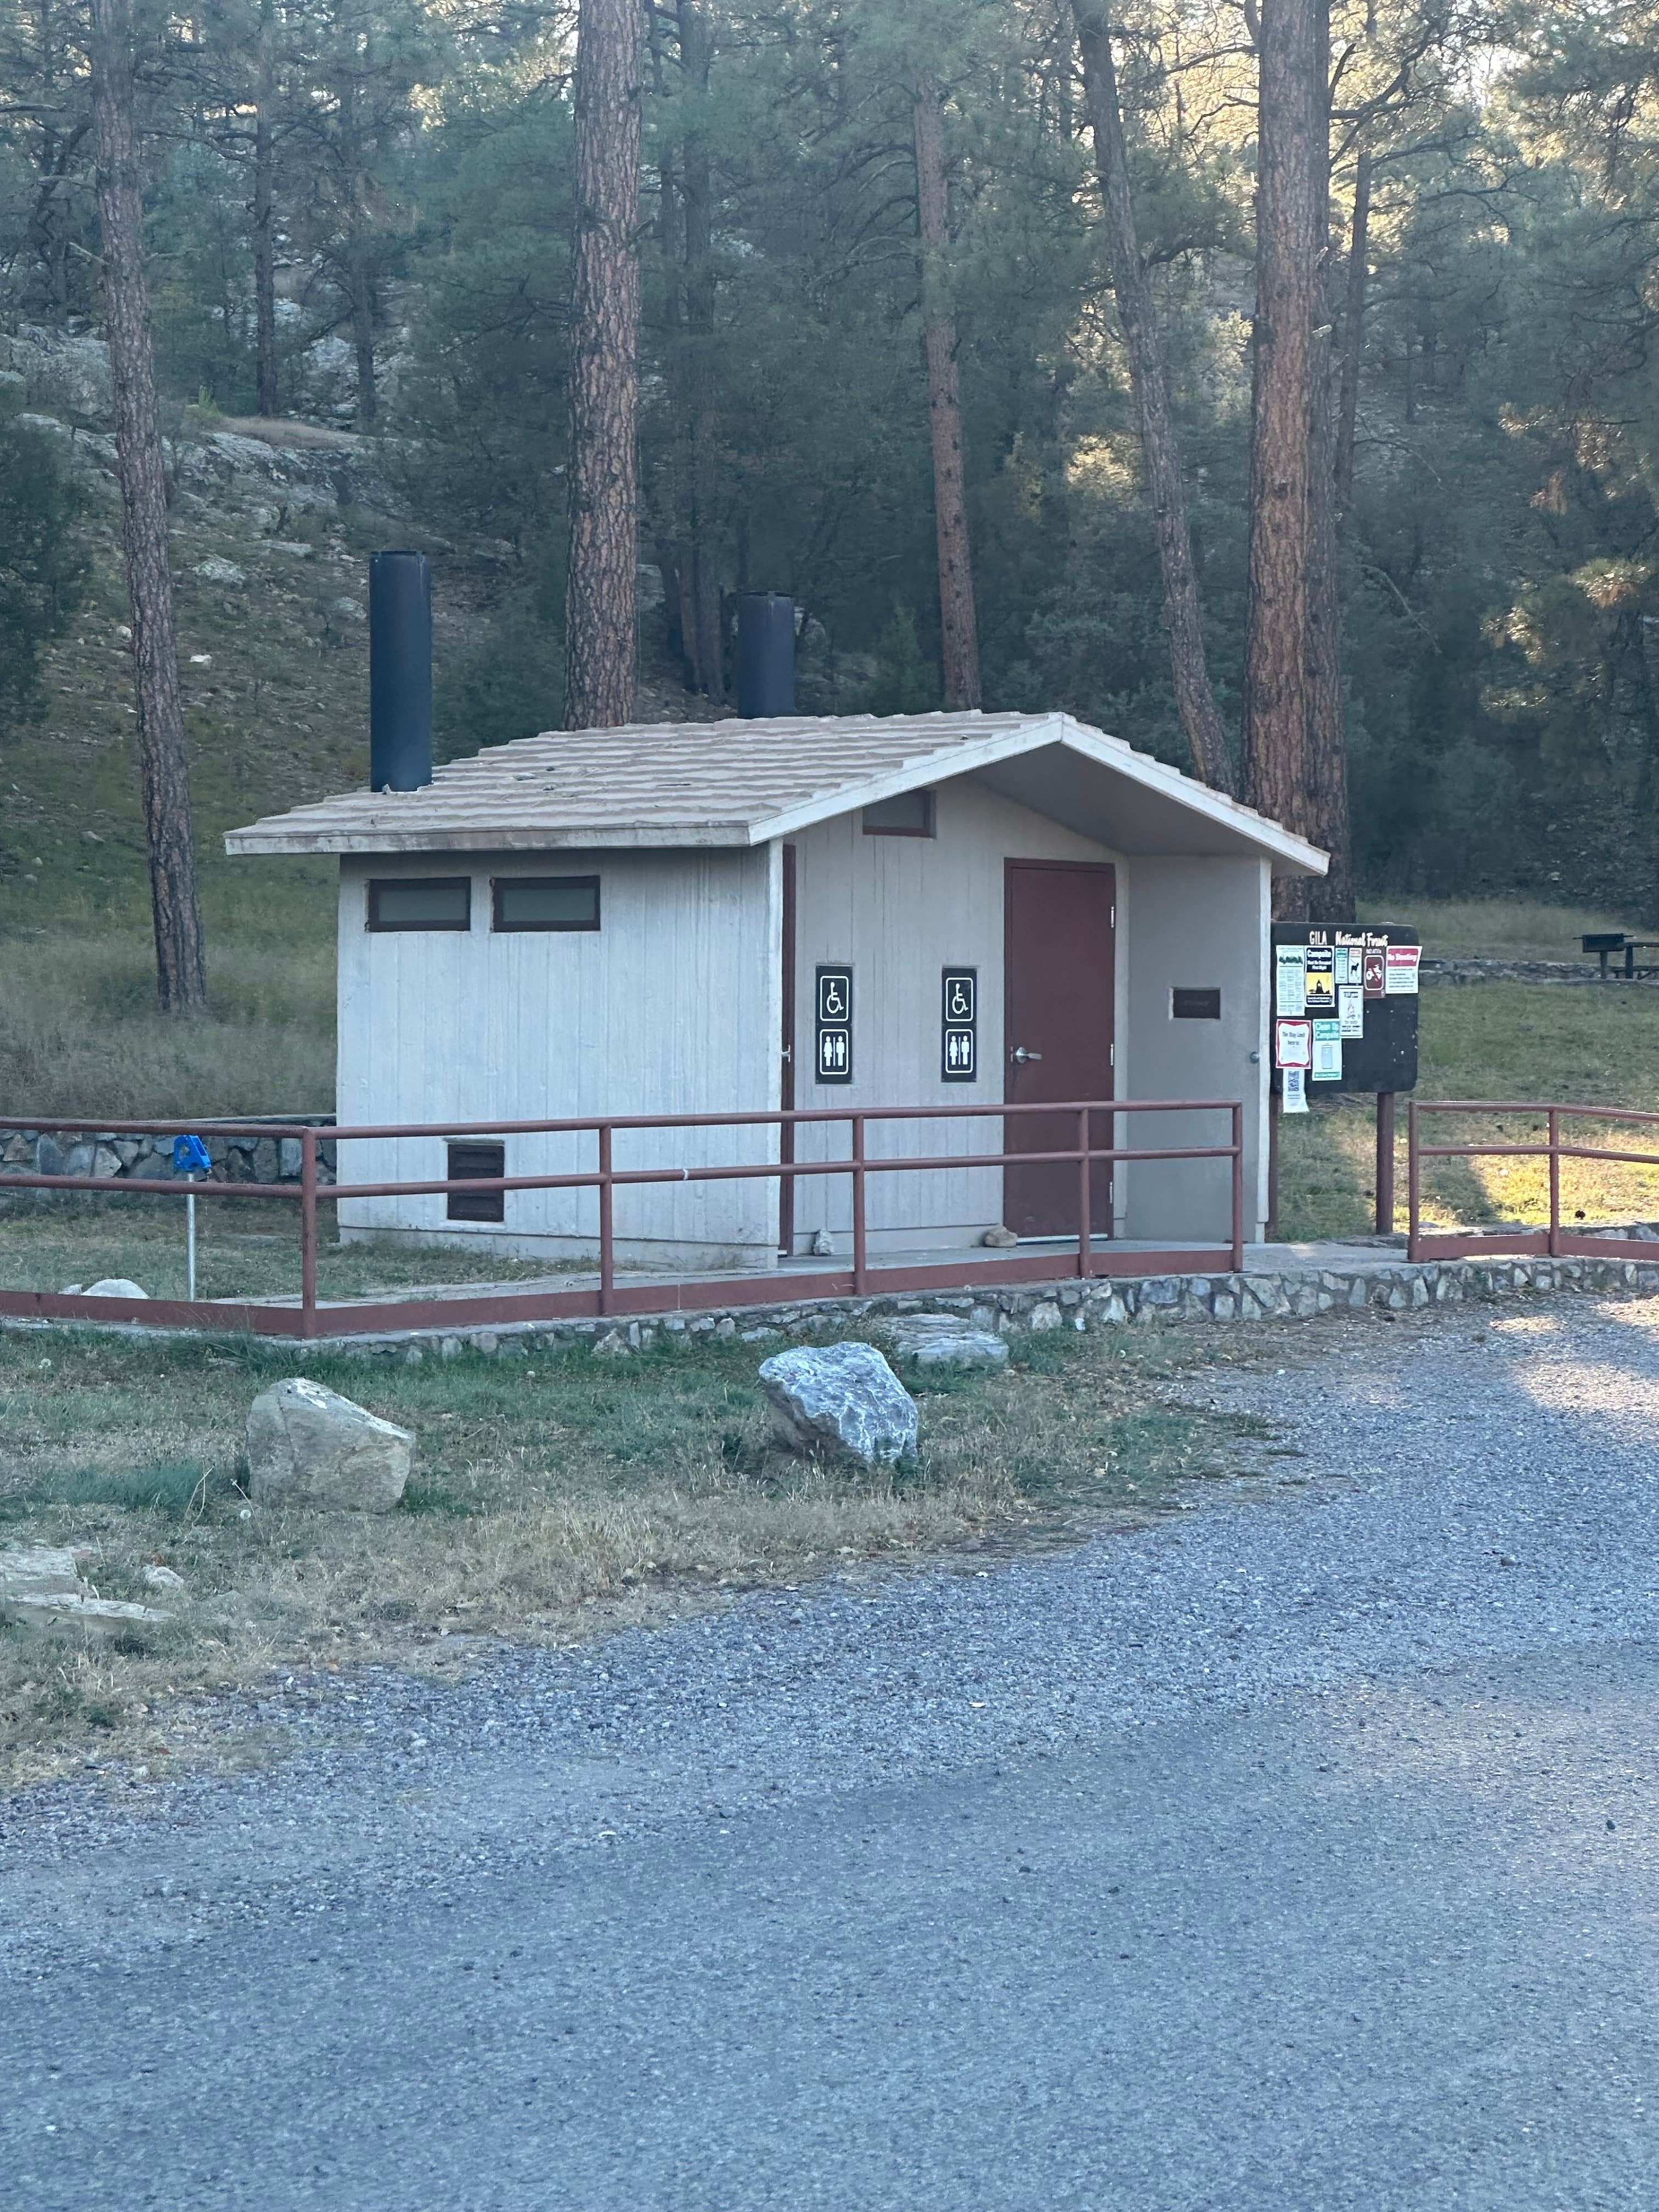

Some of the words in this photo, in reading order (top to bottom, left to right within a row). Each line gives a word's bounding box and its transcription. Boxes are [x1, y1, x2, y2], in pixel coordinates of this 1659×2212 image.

[1309, 931, 1327, 945] GILA
[1335, 931, 1365, 947] National
[1366, 932, 1389, 947] Forest
